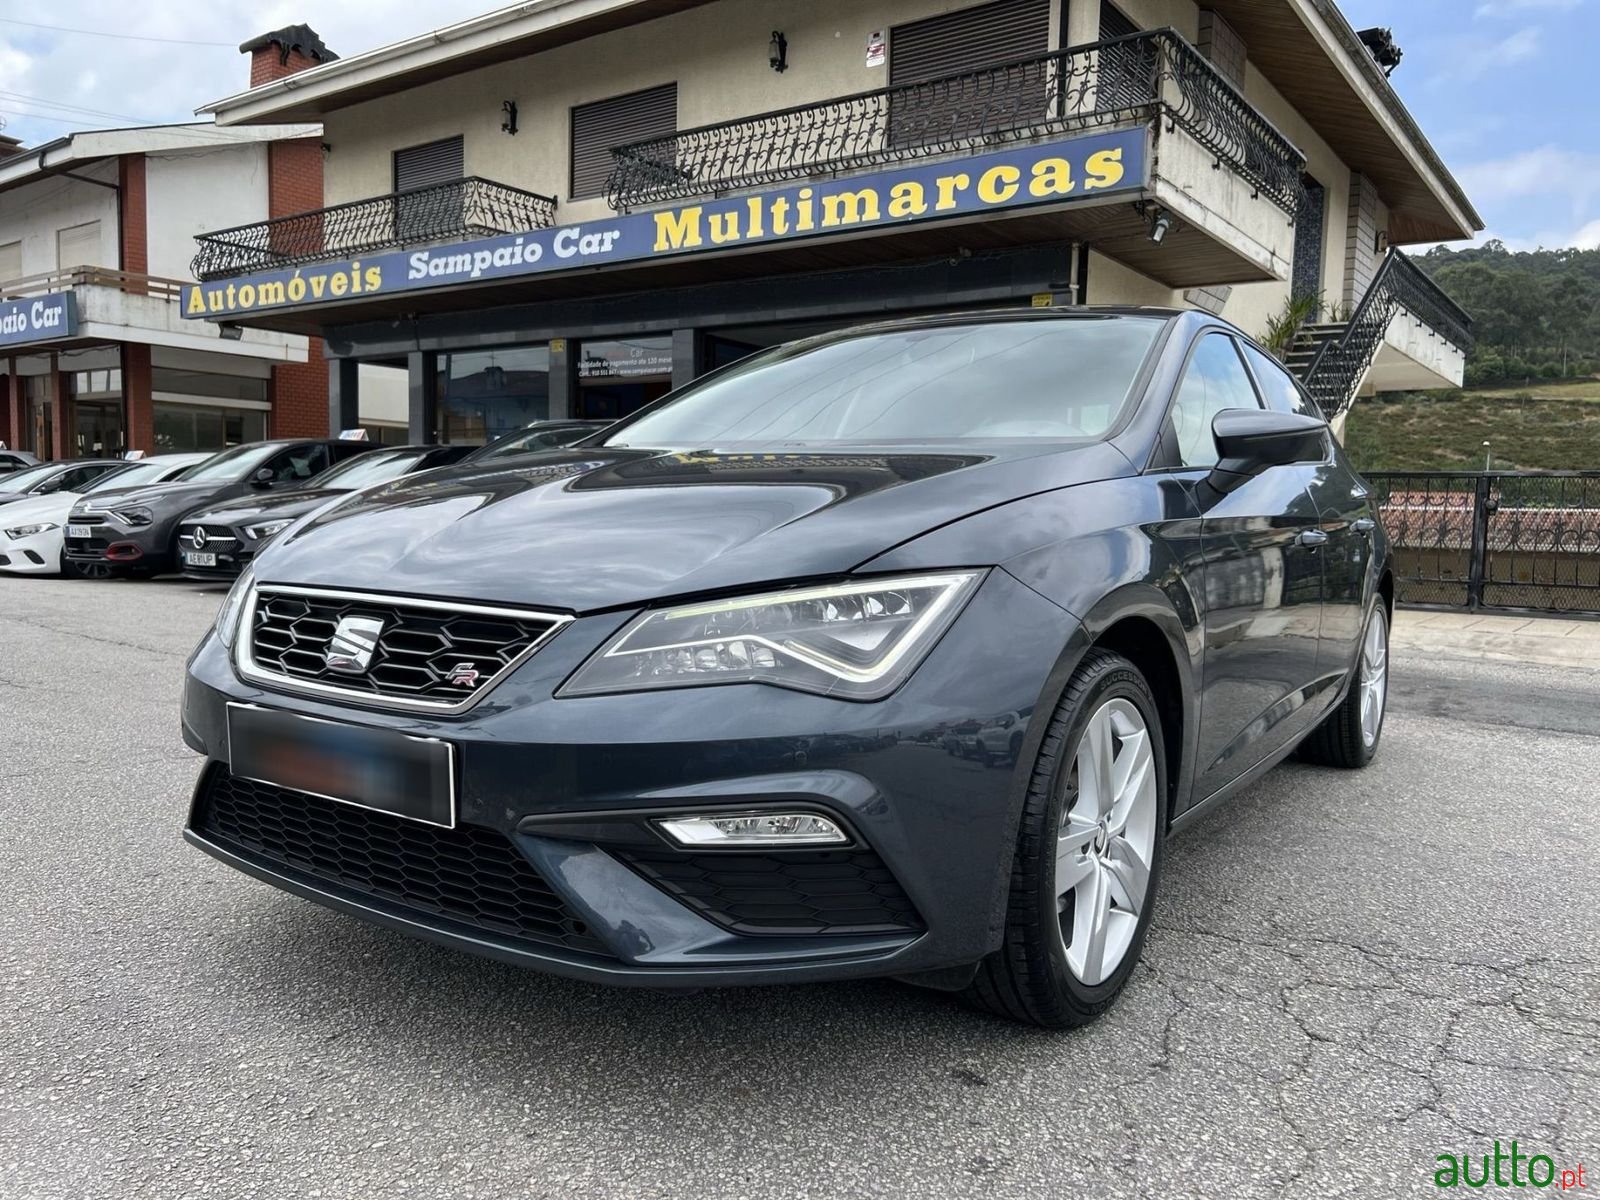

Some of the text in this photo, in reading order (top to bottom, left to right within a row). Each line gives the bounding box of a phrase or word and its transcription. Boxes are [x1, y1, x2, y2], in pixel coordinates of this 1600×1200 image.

[187, 146, 1125, 314] Automóveis Sampaio Car Multimarcas
[0, 301, 62, 335] aio Car
